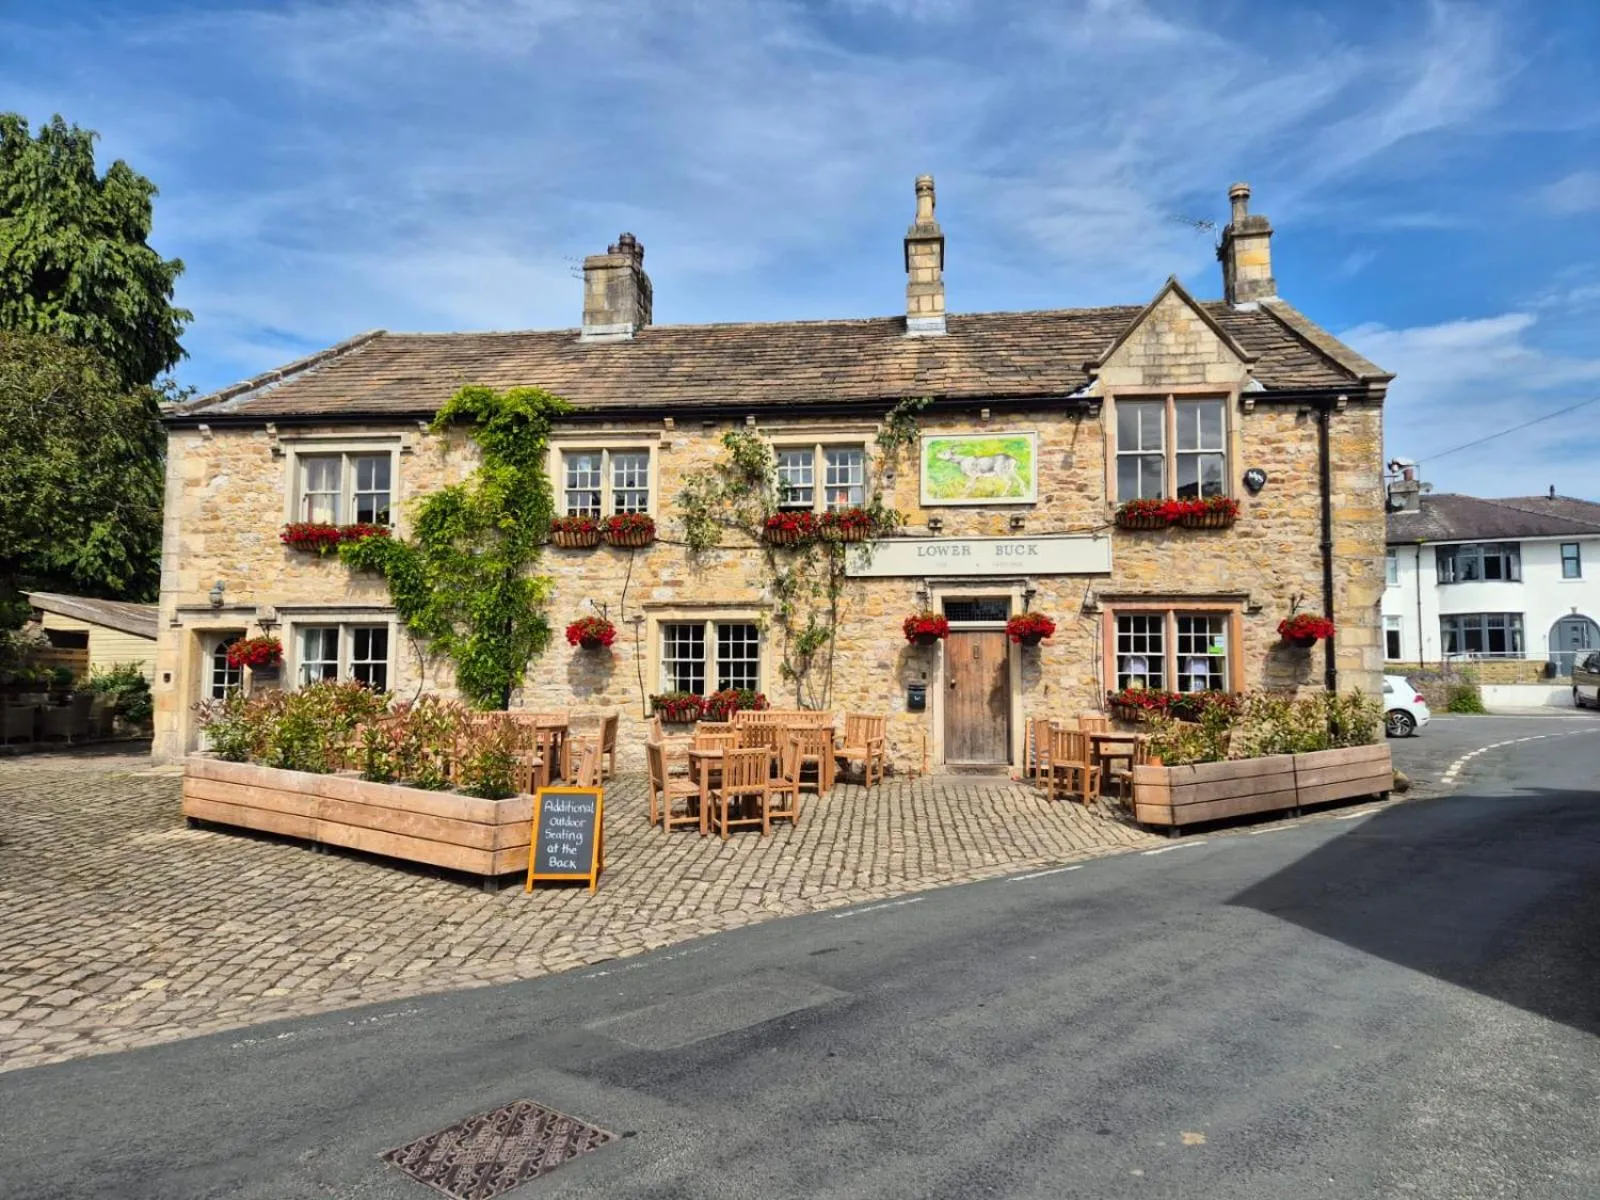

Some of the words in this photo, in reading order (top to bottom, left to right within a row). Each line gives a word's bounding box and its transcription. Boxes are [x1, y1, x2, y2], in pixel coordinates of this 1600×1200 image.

[916, 545, 971, 557] LOWER
[995, 544, 1038, 556] BUCK
[544, 799, 594, 814] Additional
[547, 843, 559, 853] at
[562, 843, 577, 855] the
